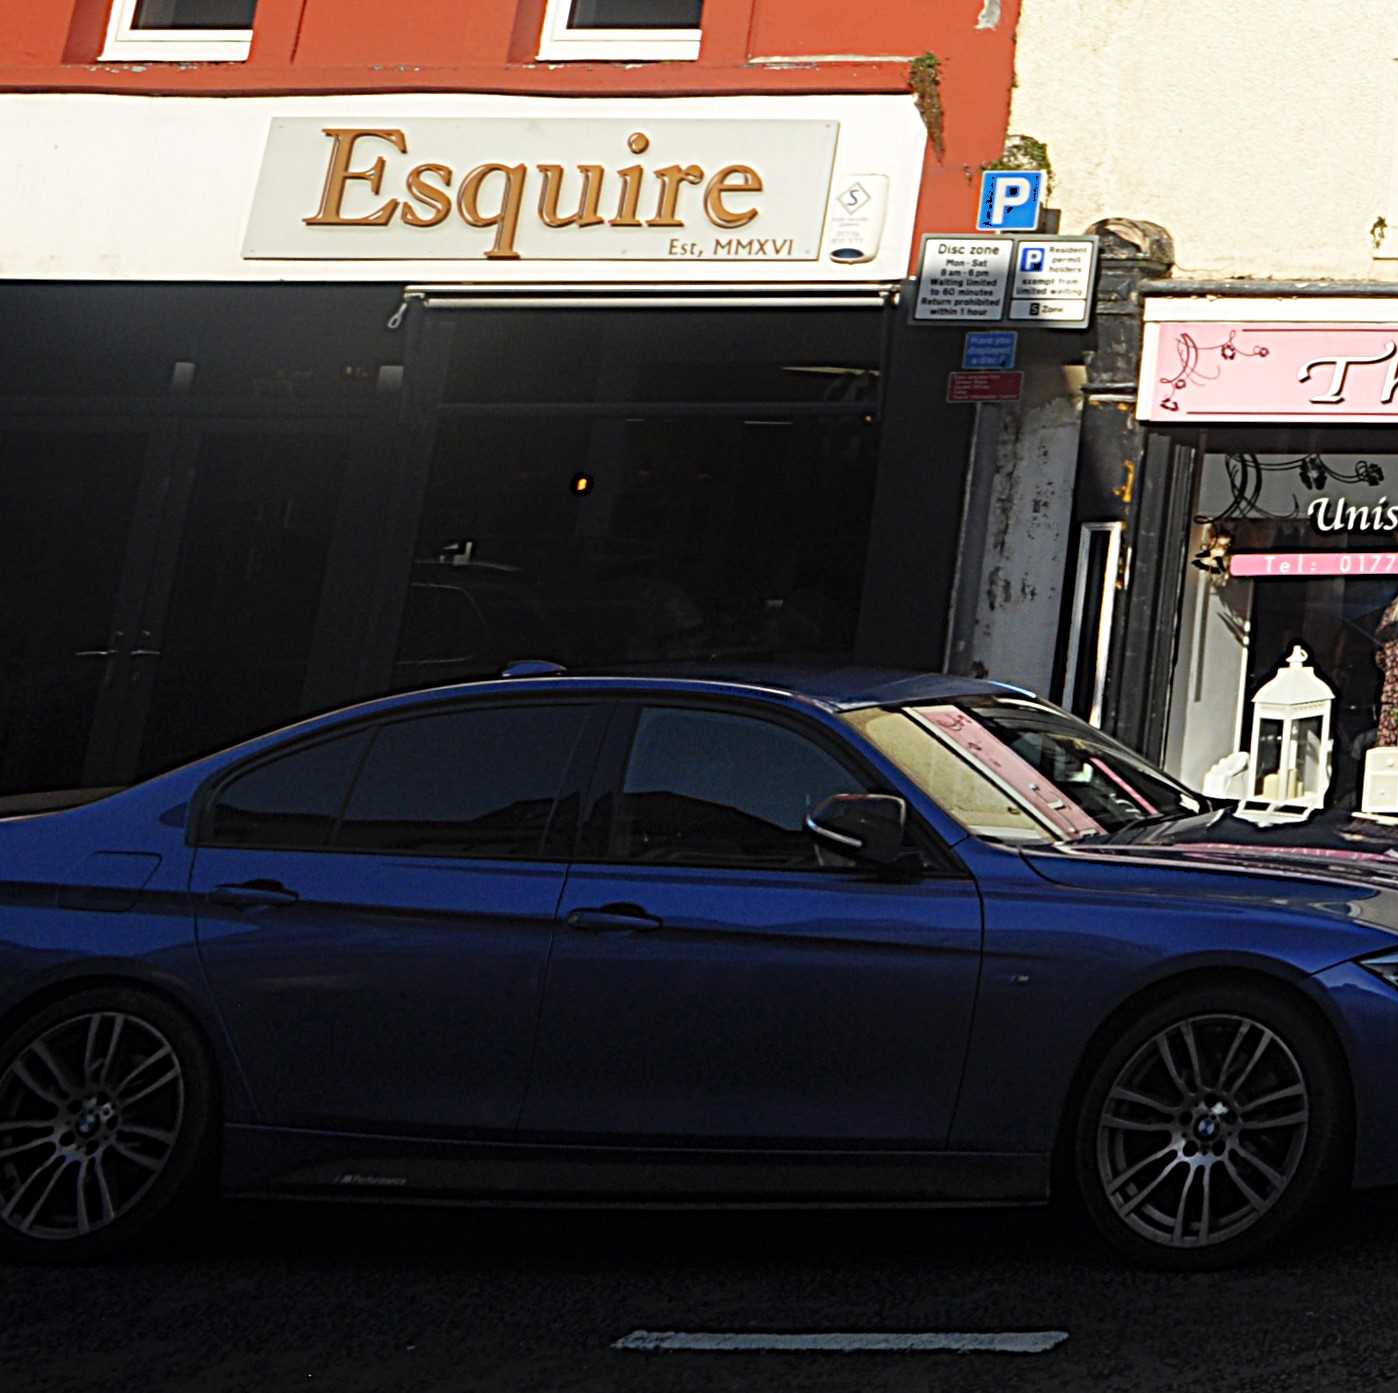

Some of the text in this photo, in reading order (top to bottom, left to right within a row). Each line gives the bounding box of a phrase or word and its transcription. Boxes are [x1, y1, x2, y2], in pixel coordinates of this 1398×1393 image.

[302, 127, 763, 260] Esquire
[991, 177, 1030, 225] P
[712, 238, 794, 256] MMXVI
[938, 243, 1000, 255] Disc zone
[1049, 246, 1088, 254] Resident
[946, 259, 964, 268] Mon
[972, 259, 988, 268] Sat
[1052, 255, 1081, 265] permit
[1049, 265, 1082, 274] holders
[930, 278, 998, 288] Waiting limited
[1022, 277, 1055, 287] exempt
[931, 288, 940, 296] to
[958, 288, 994, 296] minutes
[1016, 287, 1083, 297] limited waiting
[921, 297, 1001, 307] Return prohibited
[930, 307, 958, 316] within
[967, 307, 988, 316] hour
[1041, 305, 1064, 314] Zone
[1264, 556, 1318, 574] Tel:
